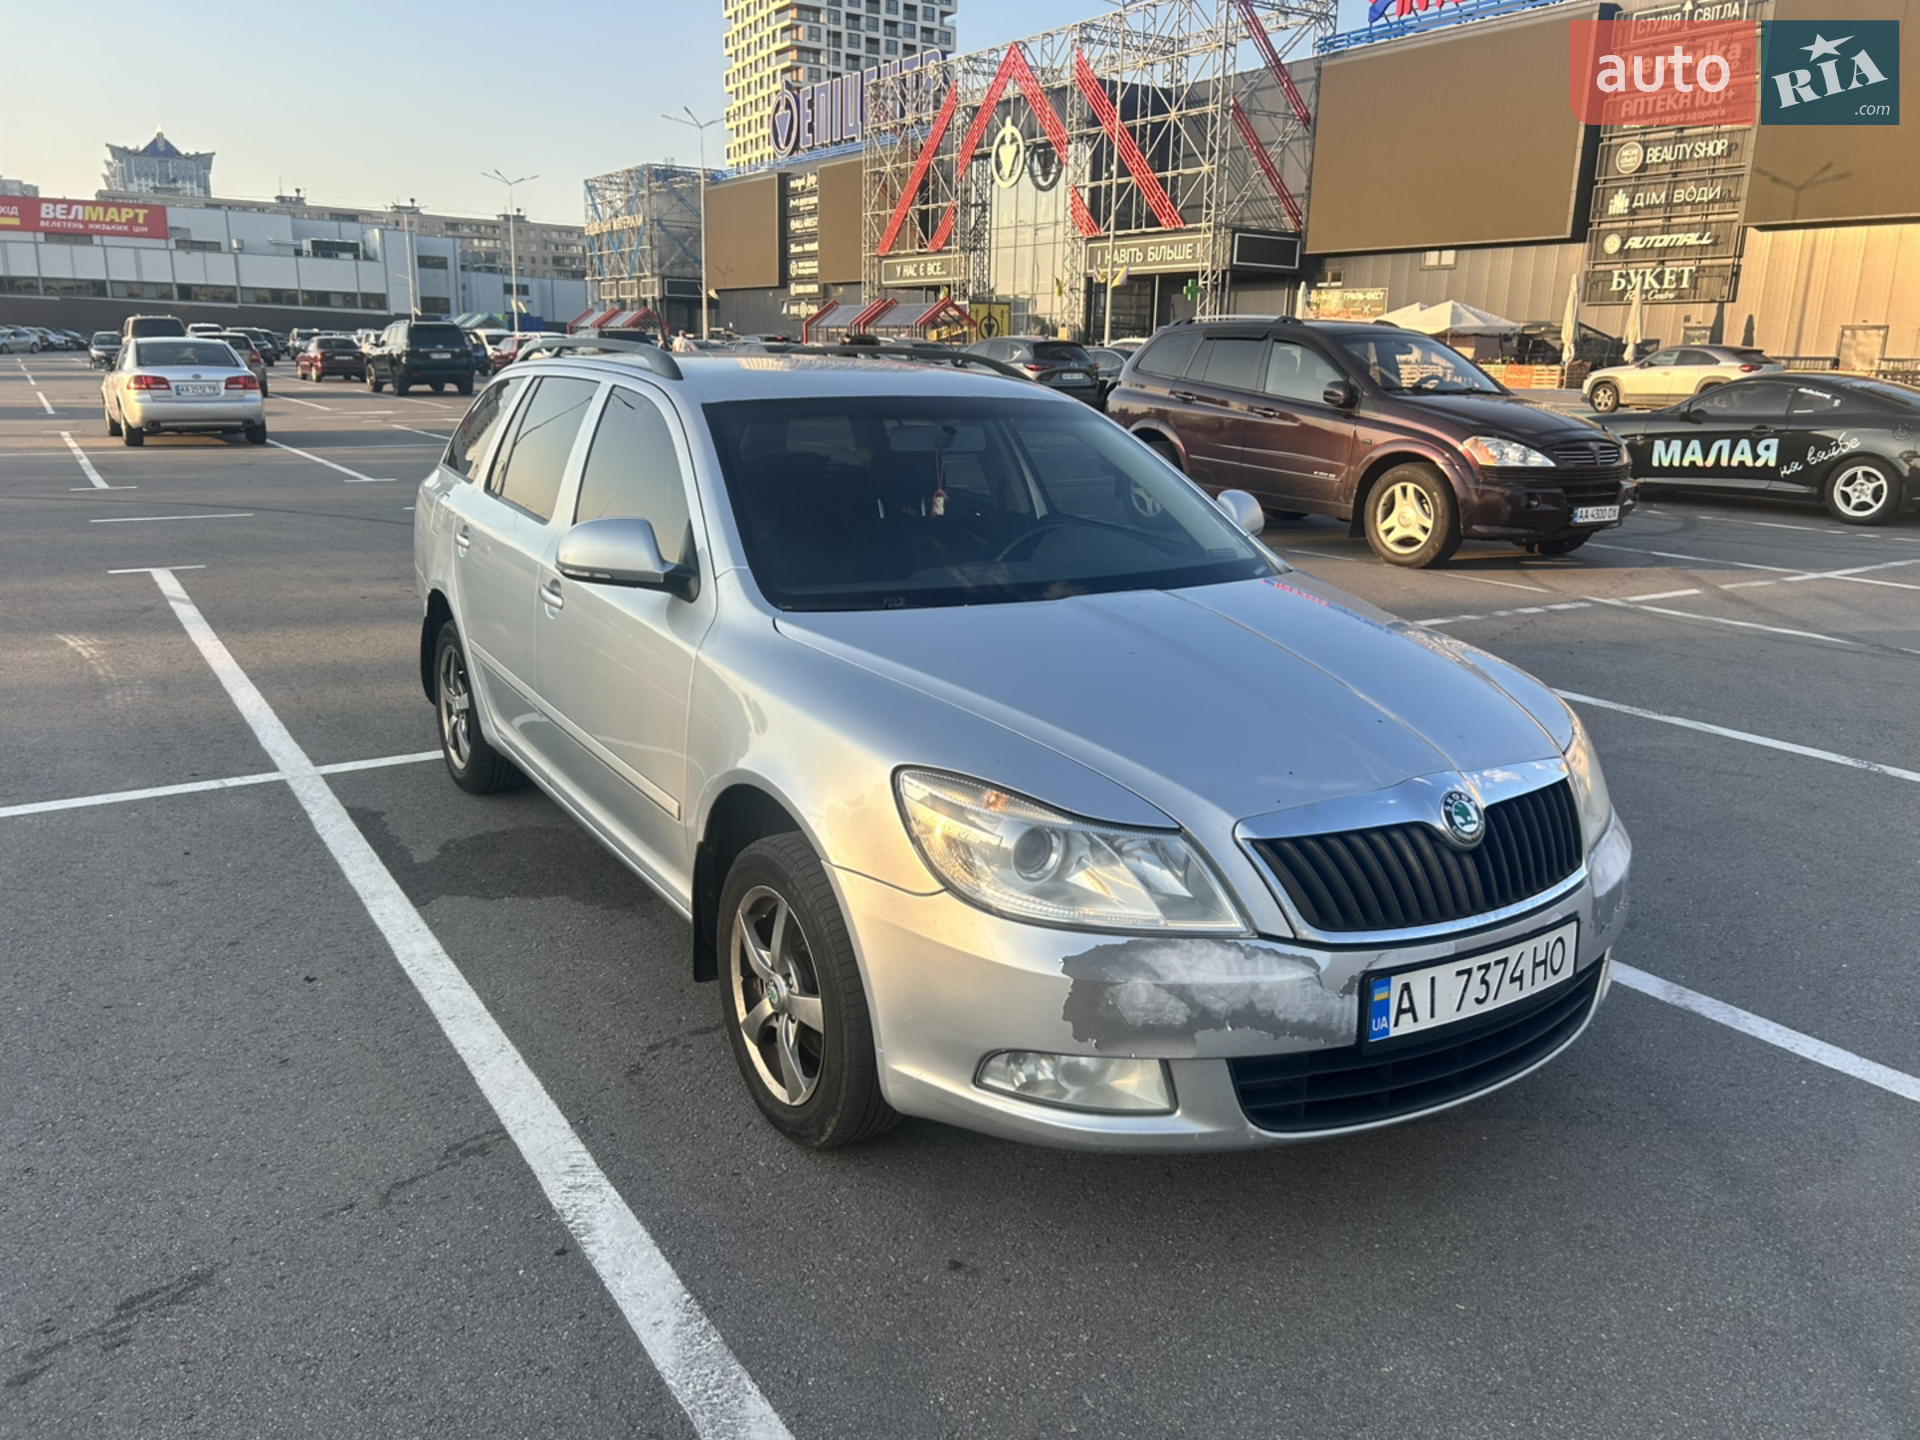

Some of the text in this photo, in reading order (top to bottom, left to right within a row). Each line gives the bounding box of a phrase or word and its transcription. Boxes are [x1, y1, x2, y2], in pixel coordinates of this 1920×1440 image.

[1693, 2, 1741, 24] СВІТЛА
[1620, 92, 1691, 118] АПТЕКА
[1645, 139, 1728, 164] BEAUTY SHOP
[1632, 185, 1721, 208] ДІМ ВОДИ
[40, 202, 149, 224] ВЕЛМАРТ
[1624, 232, 1713, 249] AUTOMALL
[1147, 243, 1194, 262] БІЛЬШЕ
[1610, 266, 1696, 291] БУКЕТ
[1651, 438, 1779, 468] МАЛАЯ
[1393, 976, 1436, 1028] AI
[1455, 951, 1525, 1012] 7374
[1372, 1017, 1389, 1031] UA
